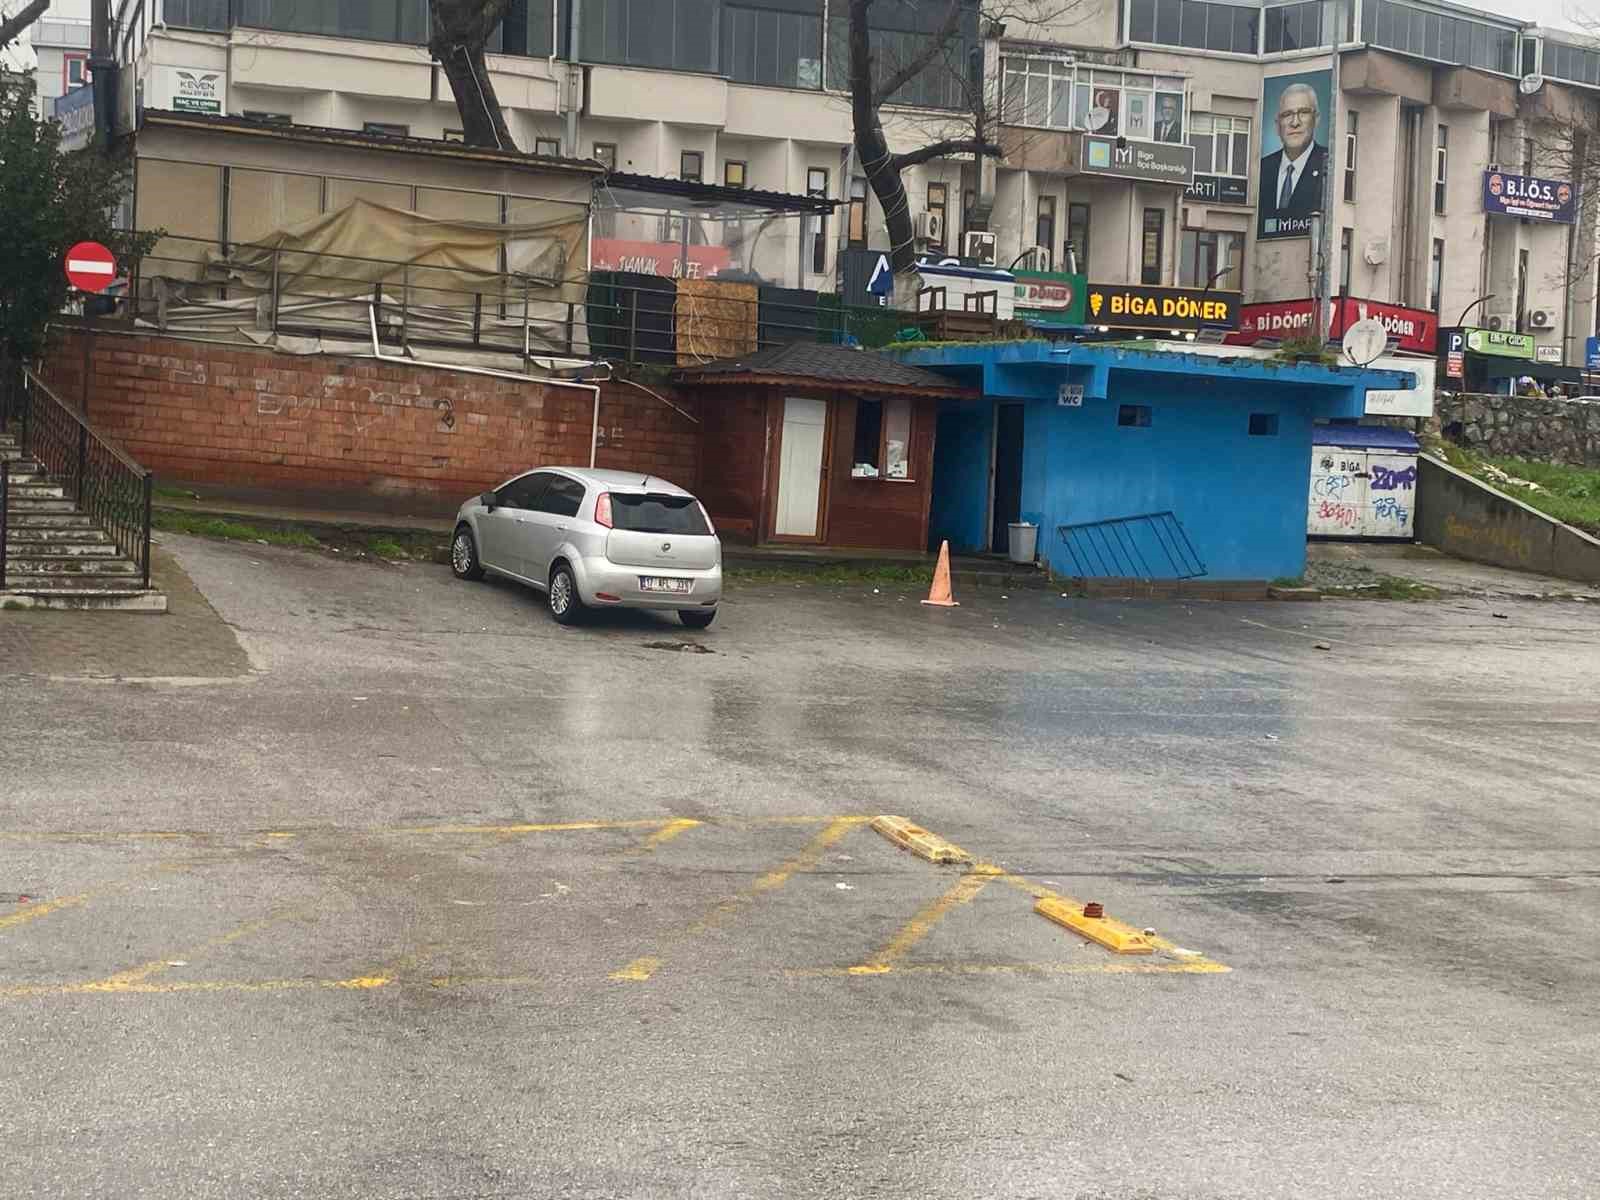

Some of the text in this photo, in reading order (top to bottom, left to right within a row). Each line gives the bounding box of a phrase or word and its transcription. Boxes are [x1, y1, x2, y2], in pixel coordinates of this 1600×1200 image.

[1185, 181, 1216, 197] ARTİ
[1507, 178, 1554, 201] B.İ.Ö.S.
[1110, 292, 1227, 320] BİGA DÖNER
[1256, 312, 1271, 331] Bİ
[1384, 314, 1414, 337] DÖNER
[1452, 335, 1462, 351] P
